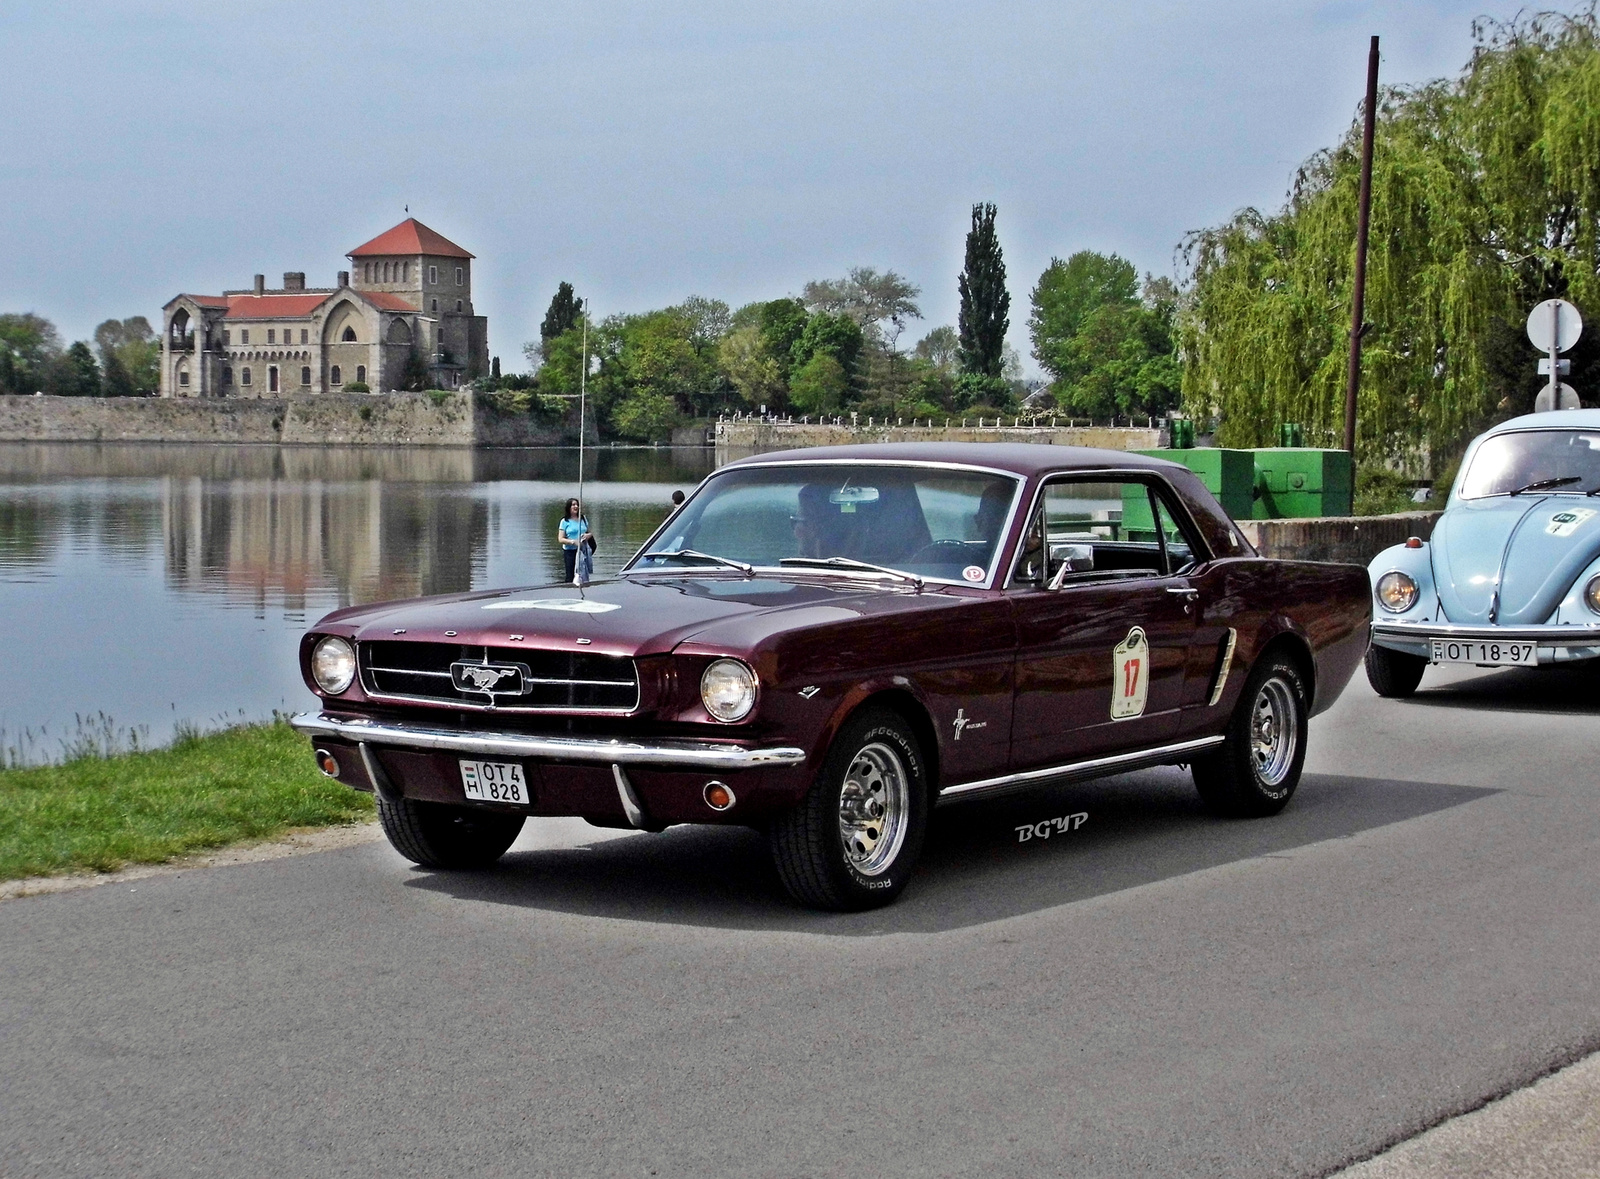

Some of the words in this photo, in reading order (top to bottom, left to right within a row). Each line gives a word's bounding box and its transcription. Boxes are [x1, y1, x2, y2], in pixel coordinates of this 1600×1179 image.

[393, 628, 592, 645] FORD
[1434, 651, 1443, 660] H
[1448, 643, 1473, 660] OT
[1480, 644, 1532, 662] 18-97
[1124, 658, 1140, 697] 17
[863, 726, 920, 778] BFGoodrich
[483, 762, 505, 782] OT
[511, 766, 520, 783] 4
[467, 780, 478, 793] H
[489, 782, 520, 801] 828
[855, 876, 892, 890] Radial
